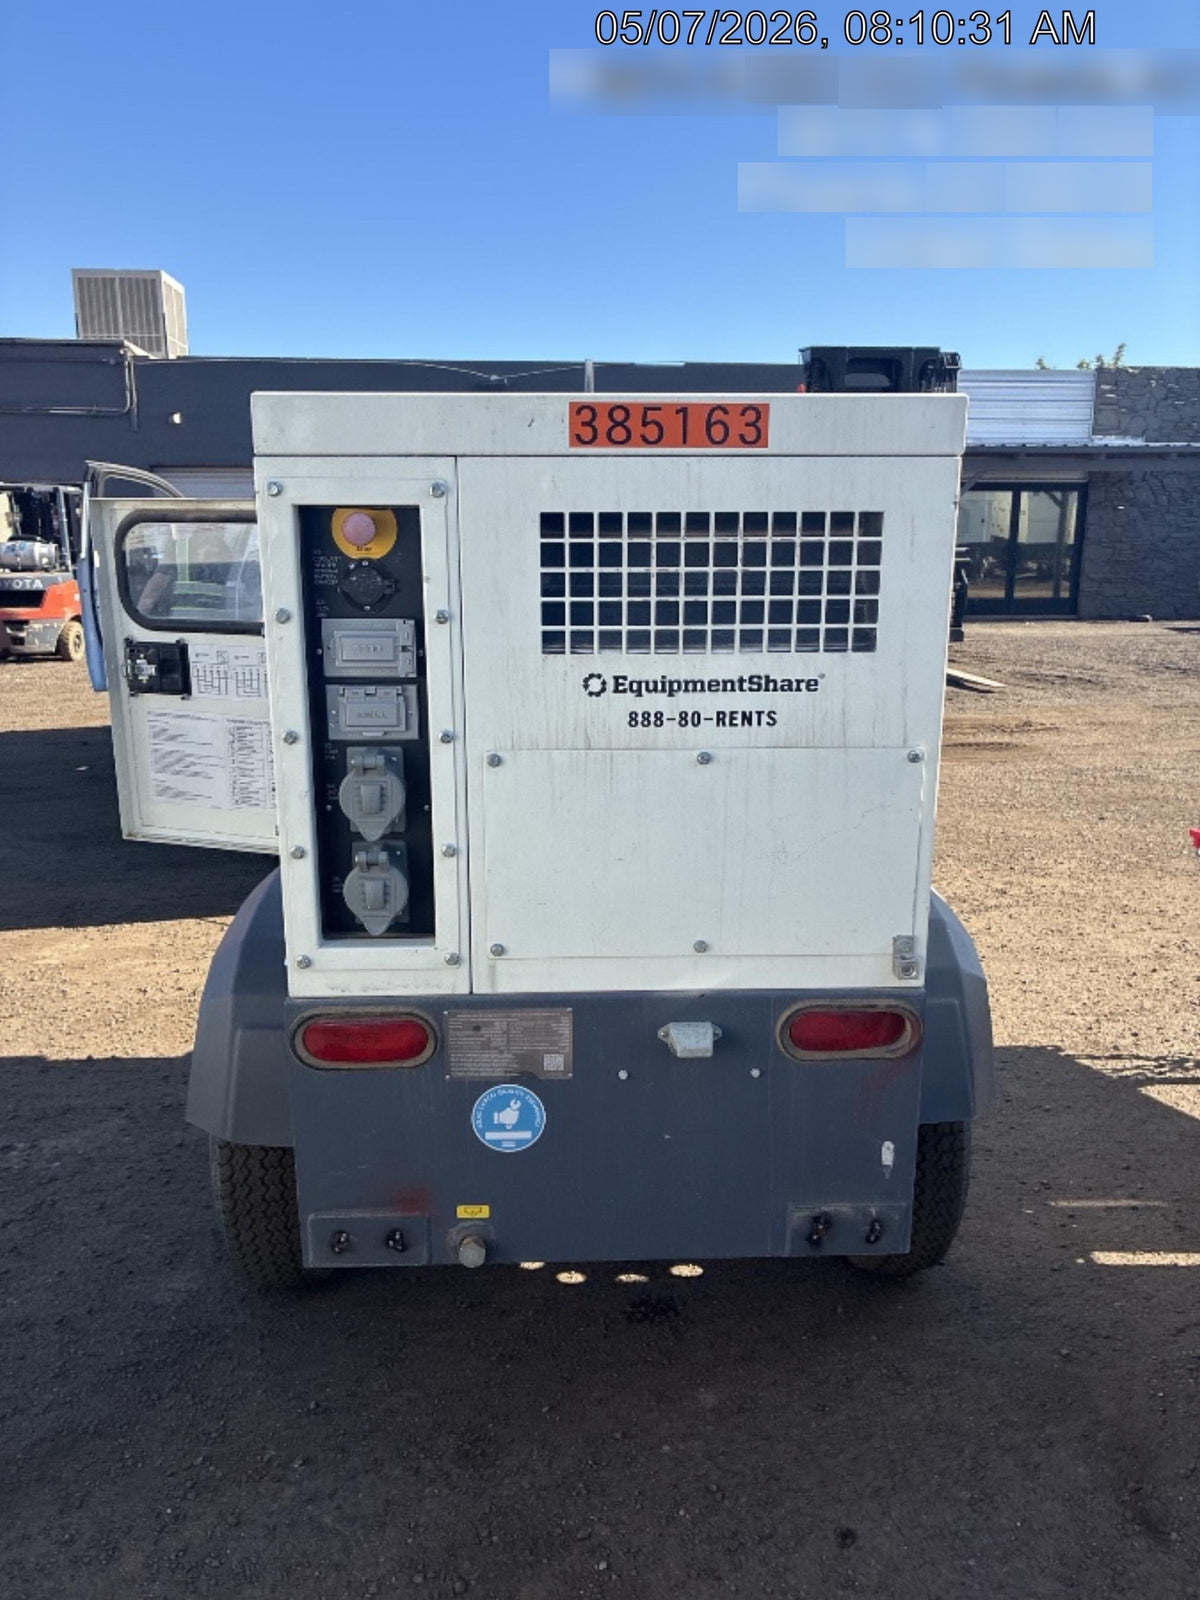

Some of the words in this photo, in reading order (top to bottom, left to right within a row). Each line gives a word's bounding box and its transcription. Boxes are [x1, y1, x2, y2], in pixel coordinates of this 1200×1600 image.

[575, 405, 761, 445] 385163
[0, 579, 43, 589] YOTA
[629, 711, 777, 727] 888-80-RENTS
